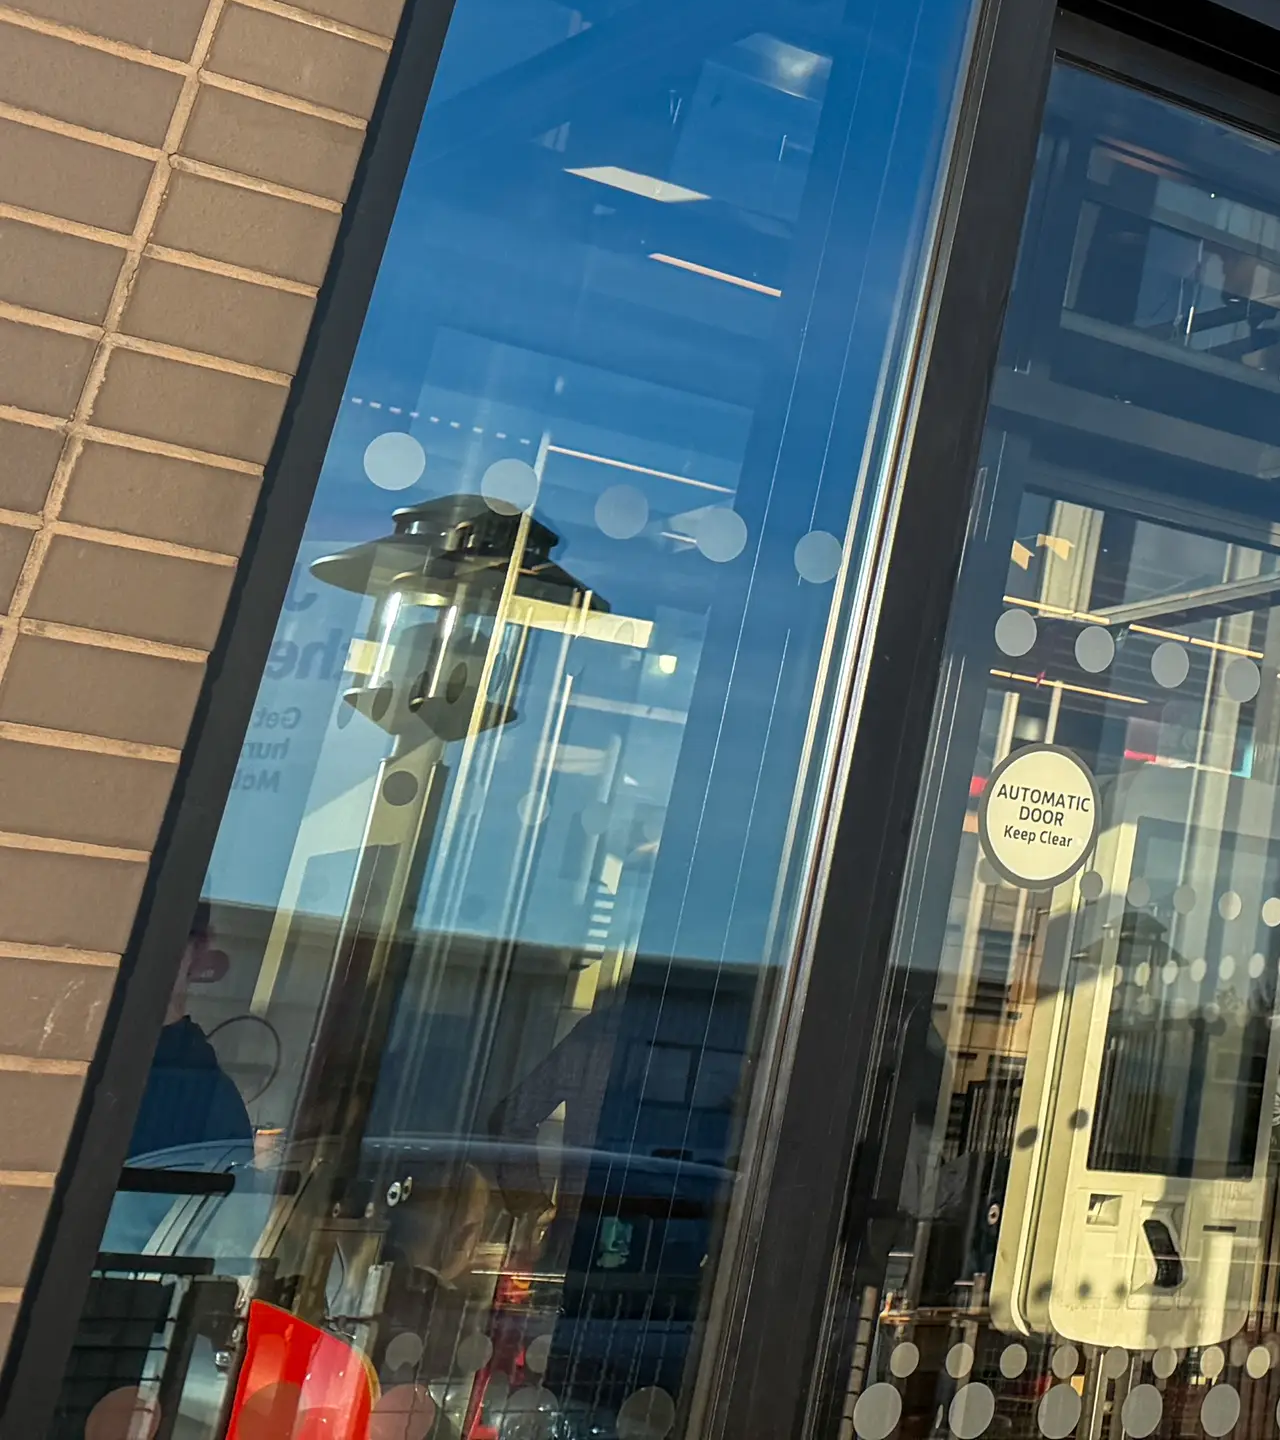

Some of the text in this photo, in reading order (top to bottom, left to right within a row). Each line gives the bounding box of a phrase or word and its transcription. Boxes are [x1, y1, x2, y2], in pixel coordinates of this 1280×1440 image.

[997, 784, 1090, 812] AUTOMATIC
[1019, 806, 1064, 826] DOOR
[1004, 825, 1073, 847] Keep Clear
